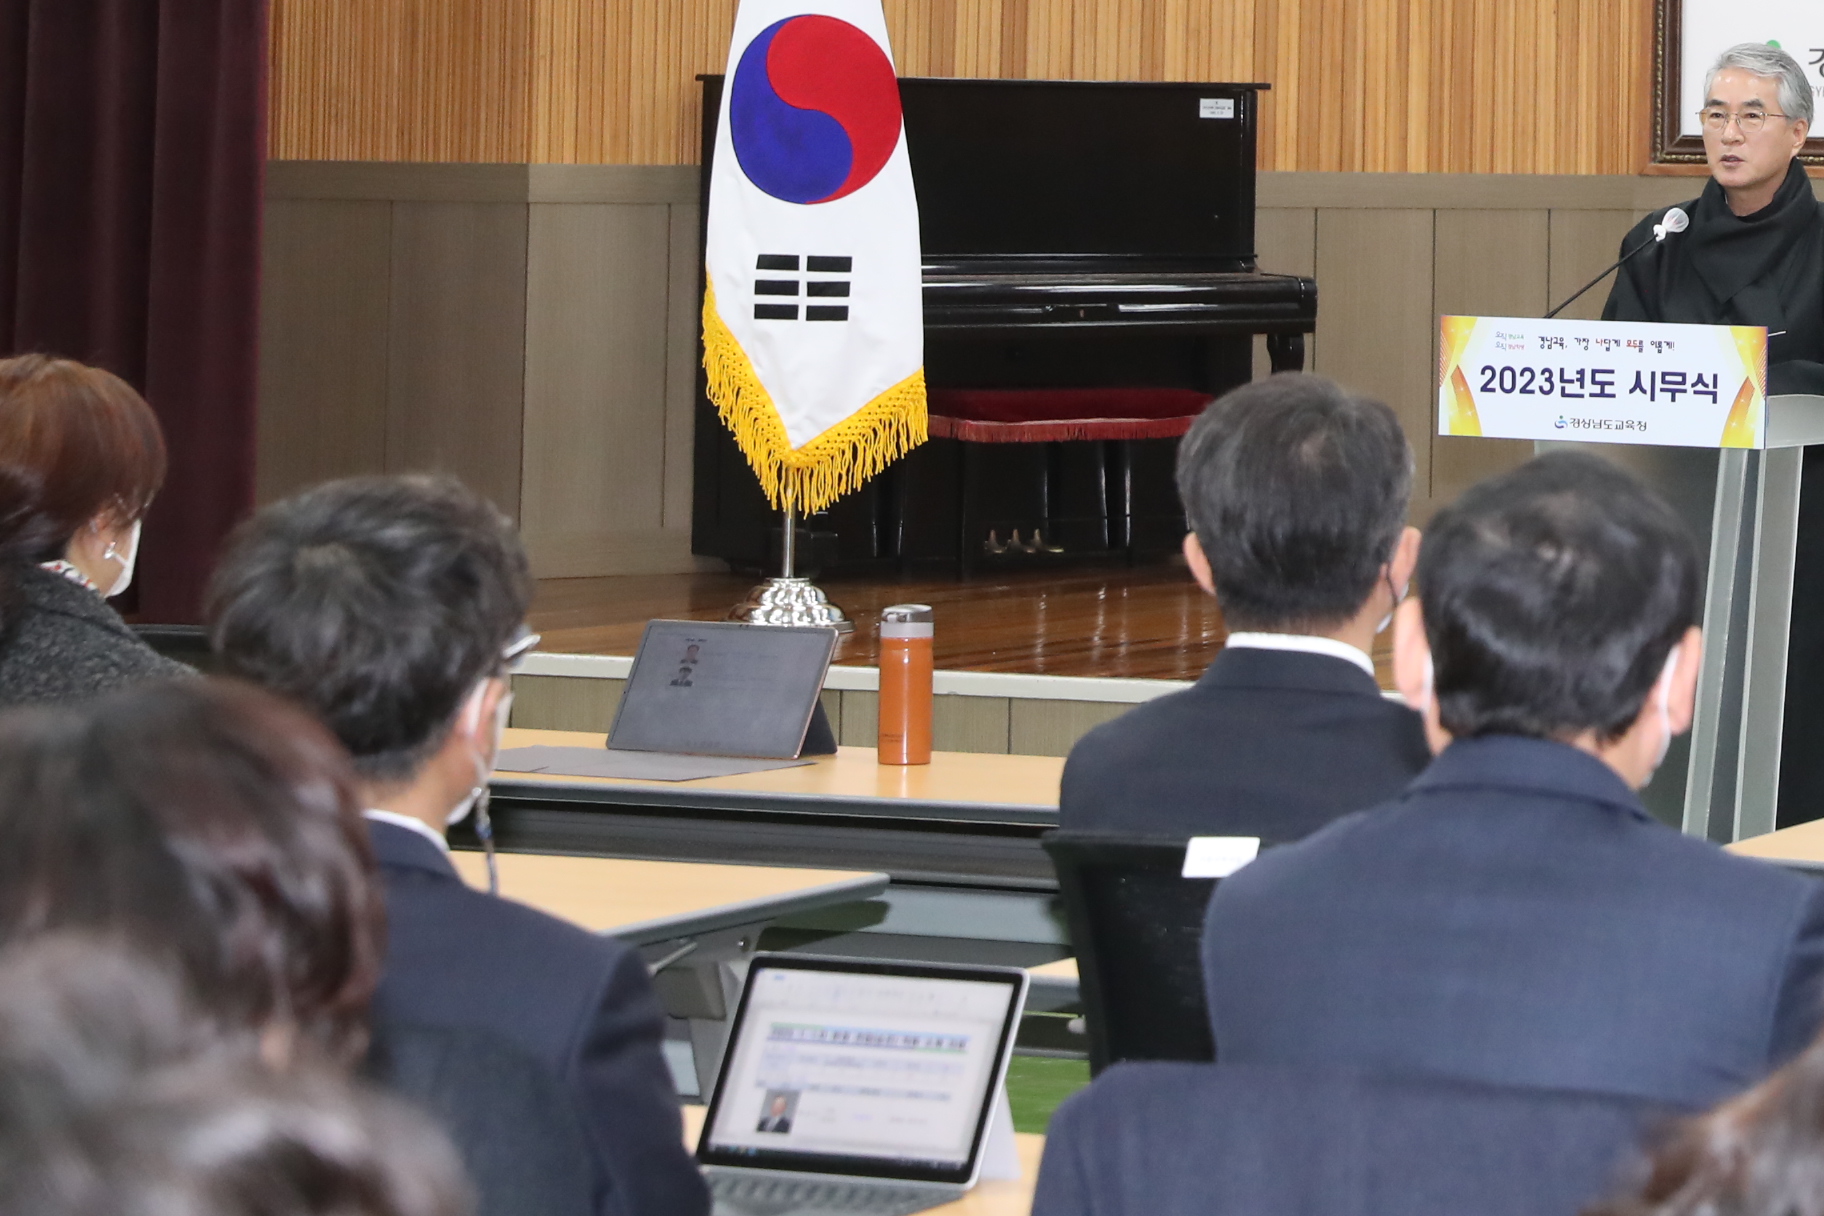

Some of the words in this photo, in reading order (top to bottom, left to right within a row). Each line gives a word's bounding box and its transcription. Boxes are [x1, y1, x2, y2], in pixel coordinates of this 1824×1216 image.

[1538, 335, 1568, 350] 경남교육,
[1574, 337, 1590, 351] 가장
[1595, 338, 1621, 352] 나답게
[1626, 339, 1644, 353] 모두를
[1650, 340, 1675, 354] 이롭게!
[1479, 364, 1617, 400] 2023년도
[1628, 370, 1719, 404] 시무식
[1569, 416, 1648, 432] 경상남도교육청
